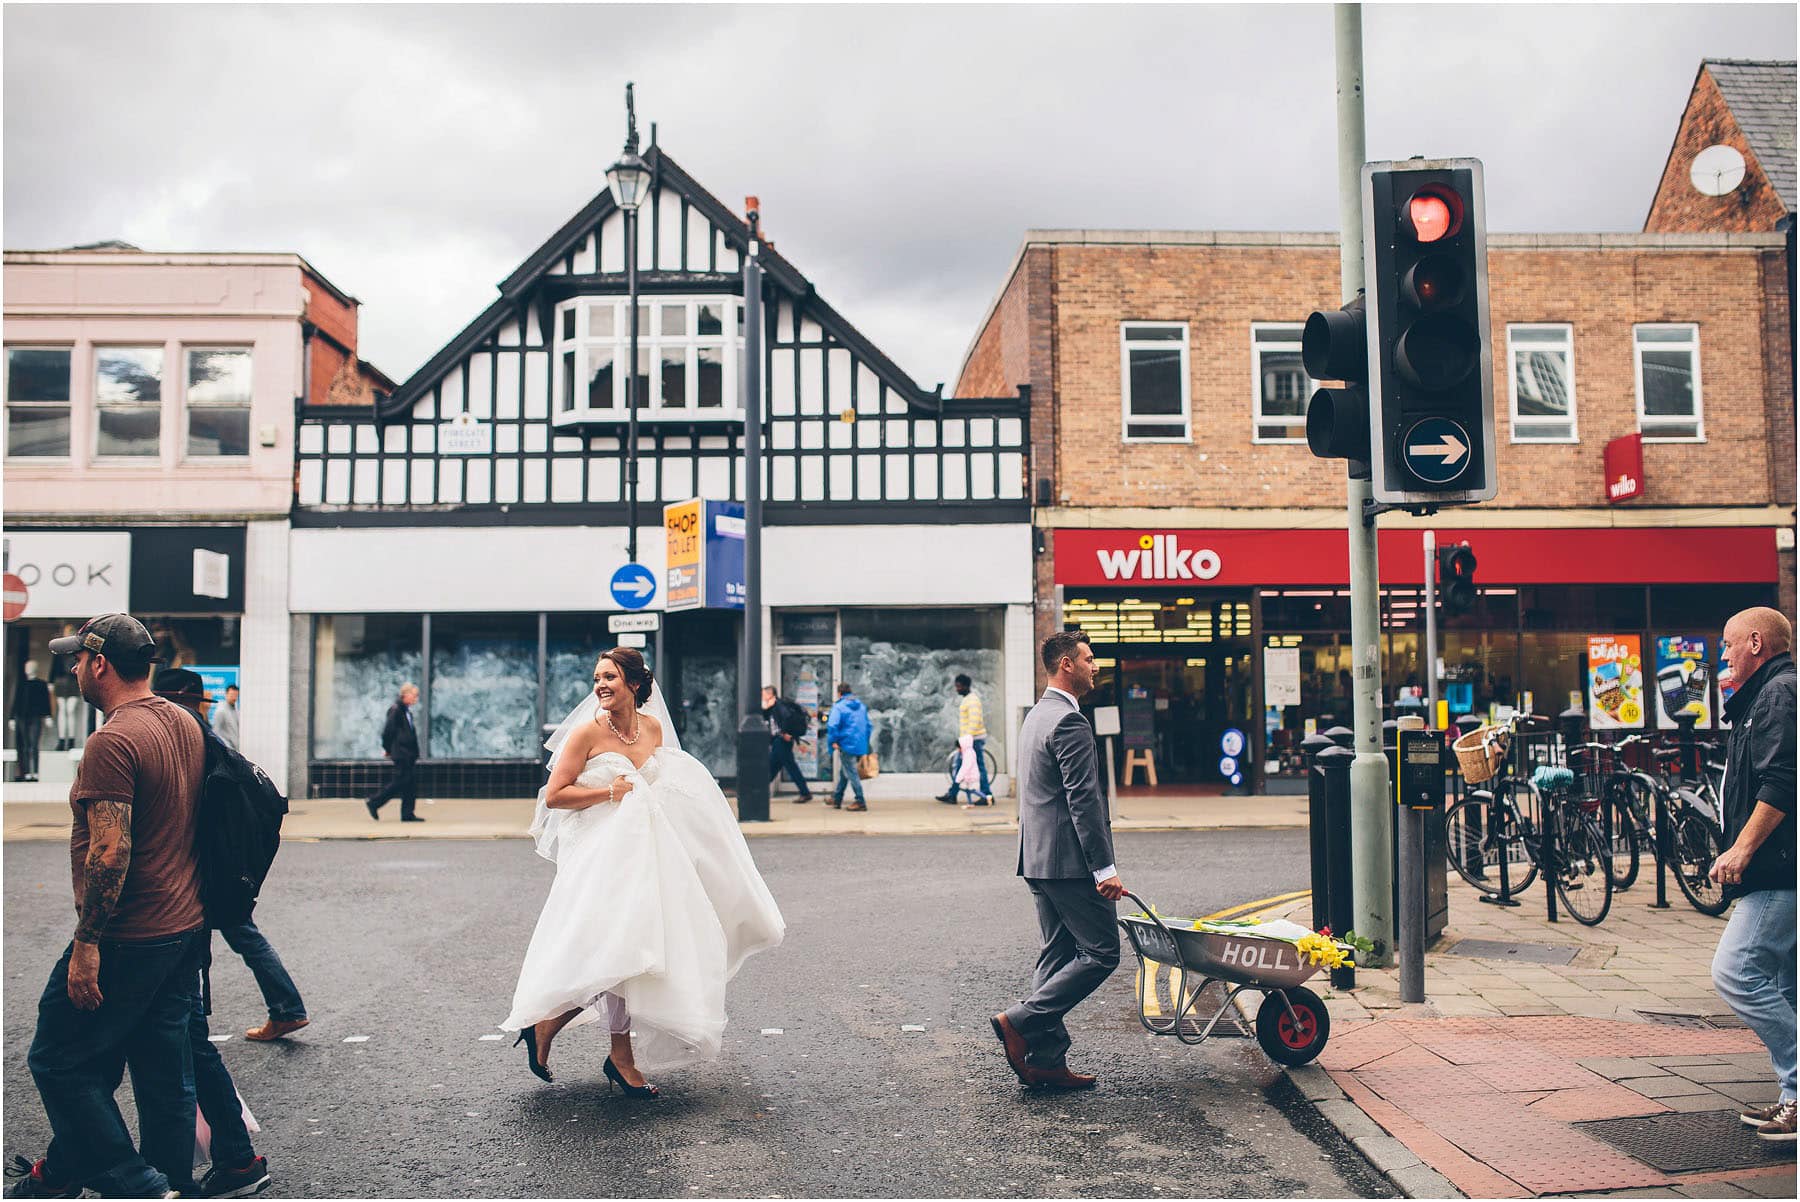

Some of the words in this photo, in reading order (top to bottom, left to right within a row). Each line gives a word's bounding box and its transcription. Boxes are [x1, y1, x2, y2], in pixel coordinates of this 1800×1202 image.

[1610, 473, 1637, 498] wilko
[667, 512, 698, 537] SHOP
[667, 538, 679, 556] TO
[681, 535, 697, 553] LET
[1096, 534, 1222, 580] wilko
[1221, 941, 1308, 971] HOLLY
